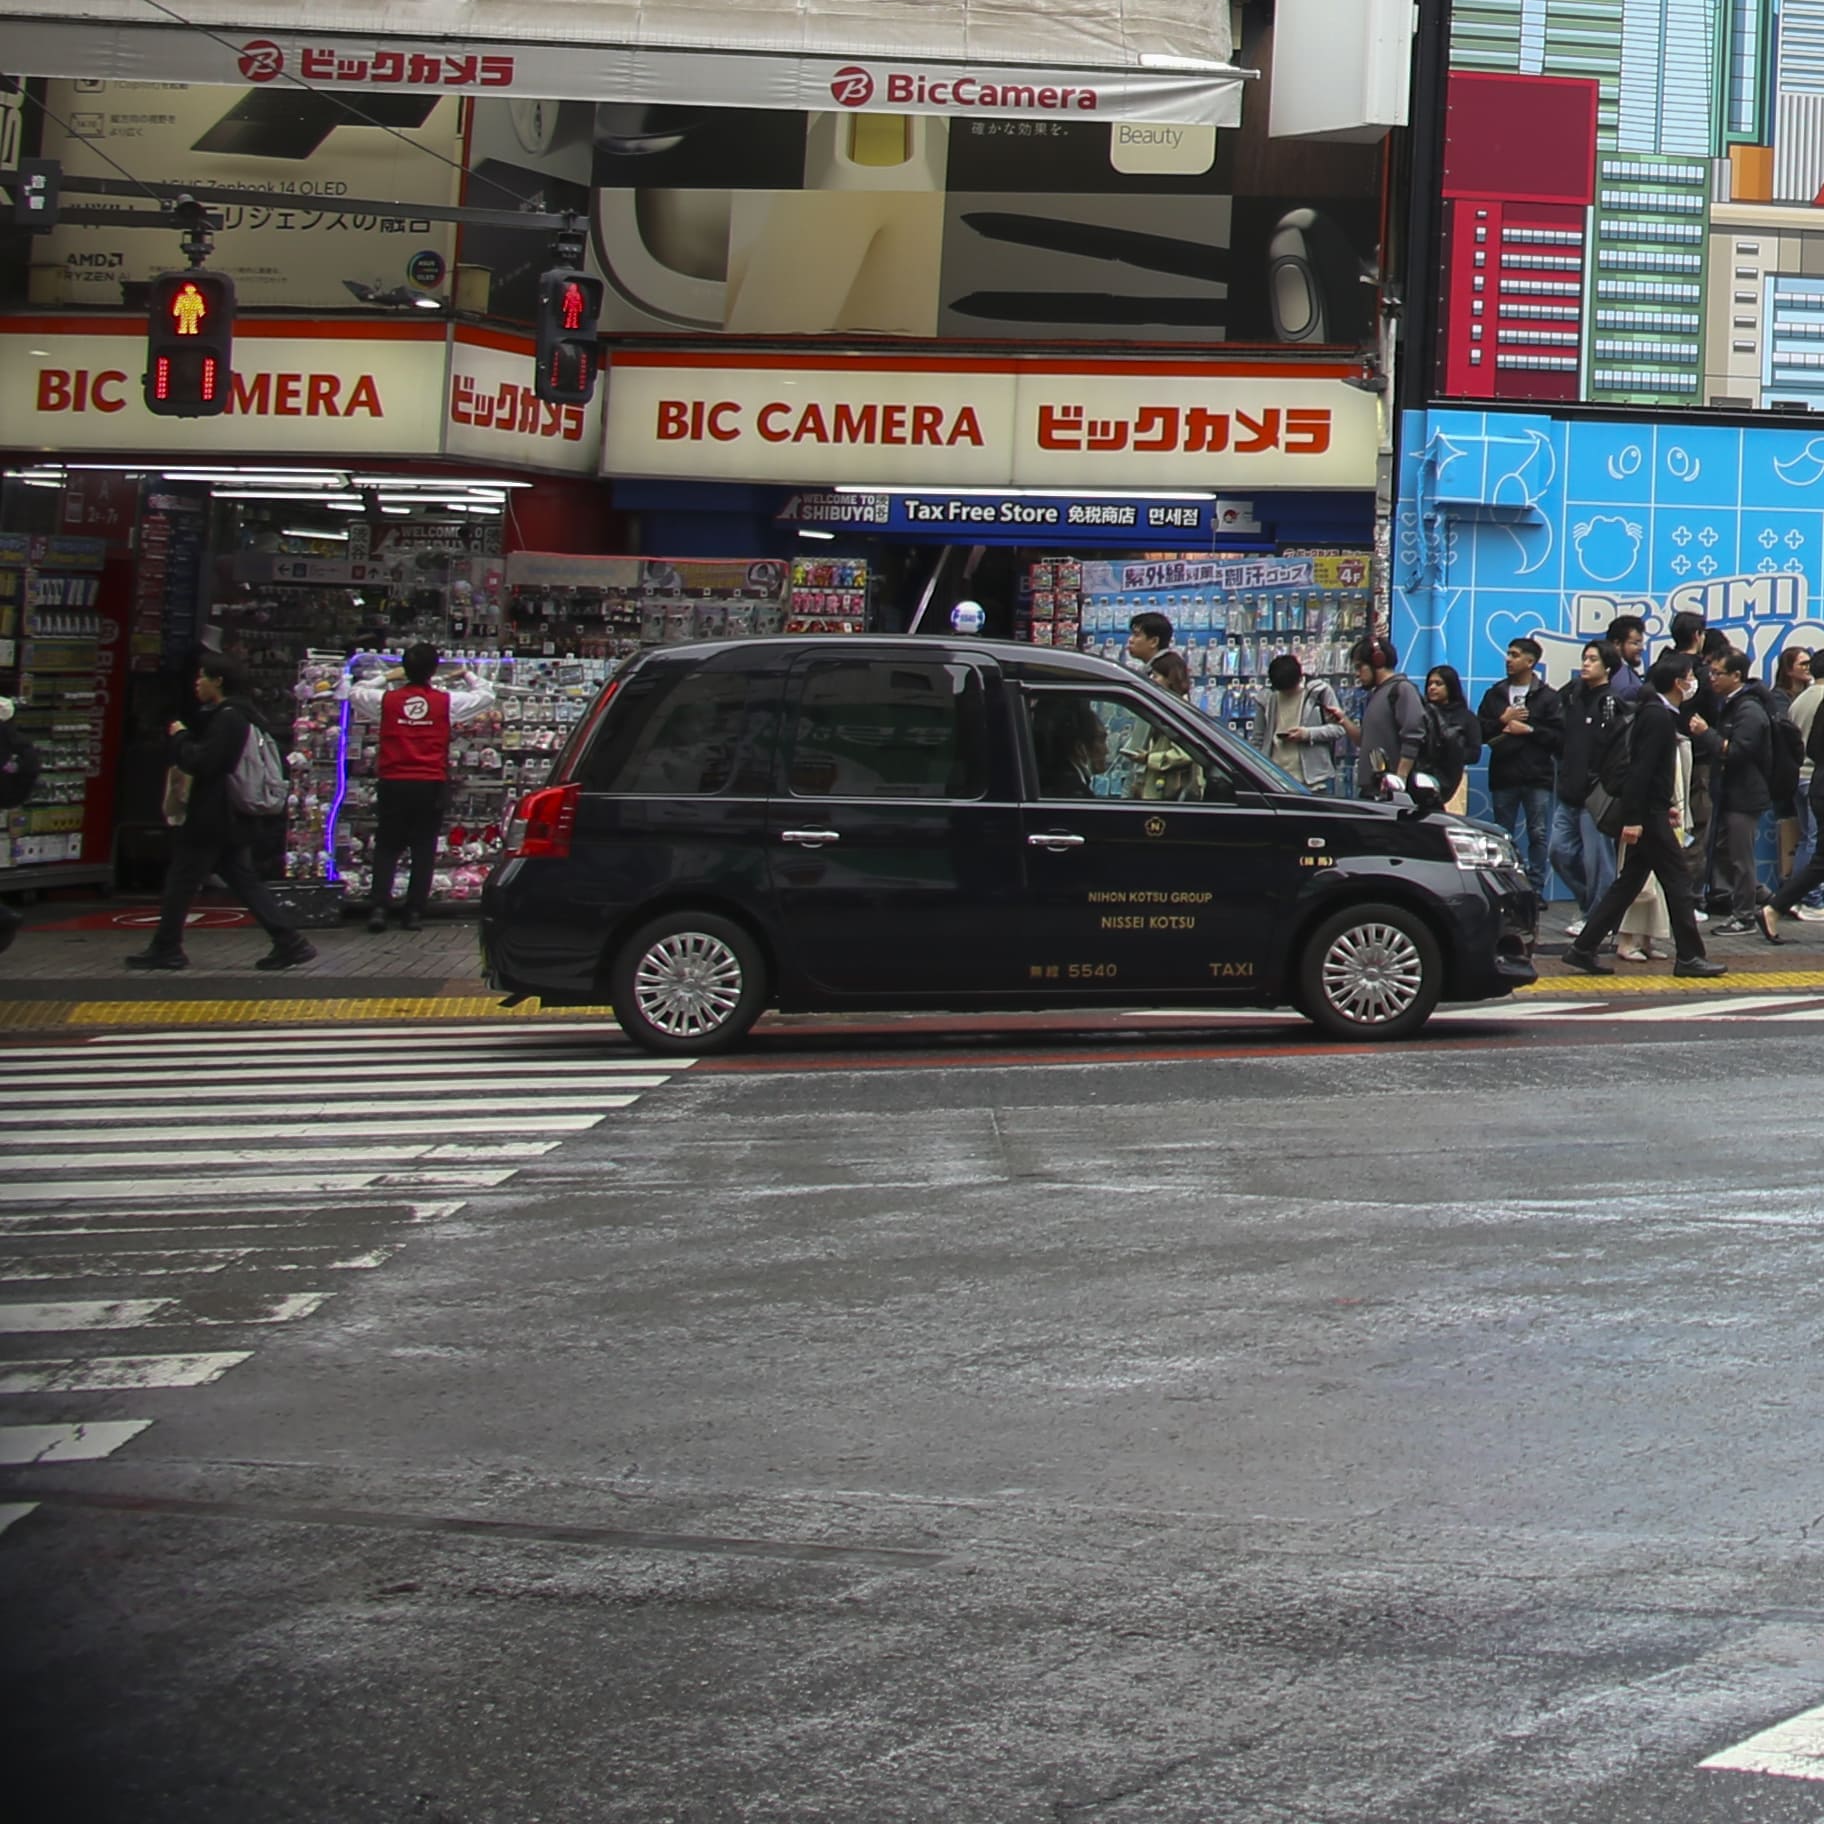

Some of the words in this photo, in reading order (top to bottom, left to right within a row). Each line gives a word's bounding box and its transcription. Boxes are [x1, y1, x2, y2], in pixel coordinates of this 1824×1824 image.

[300, 48, 514, 87] ビックカメラ
[886, 73, 1098, 111] BicCamera
[970, 121, 1070, 138] 確かな効果を。
[1118, 125, 1184, 149] Beauty
[279, 181, 296, 194] 14
[299, 181, 348, 196] OLED
[66, 253, 108, 268] AMD
[37, 368, 129, 413] BIC
[222, 372, 384, 418] MERA
[655, 400, 741, 442] BIC
[756, 403, 985, 448] CAMERA
[1037, 403, 1333, 455] ビックカメラ
[862, 495, 876, 504] TO
[802, 505, 875, 522] SHIBUYA
[904, 500, 944, 521] Tax
[948, 501, 996, 522] Free
[1000, 502, 1060, 524] Store
[1067, 505, 1136, 526] 免税商店
[1148, 507, 1199, 527] 면세점
[1670, 576, 1801, 623] SIMI
[1087, 891, 1127, 903] NIHON
[1128, 891, 1169, 904] KOTSU
[1170, 892, 1213, 904] GROUP
[1100, 916, 1145, 929] NISSEI
[1149, 916, 1196, 929] KOTSU
[1067, 963, 1118, 978] 5540
[1208, 962, 1254, 977] TAXI
